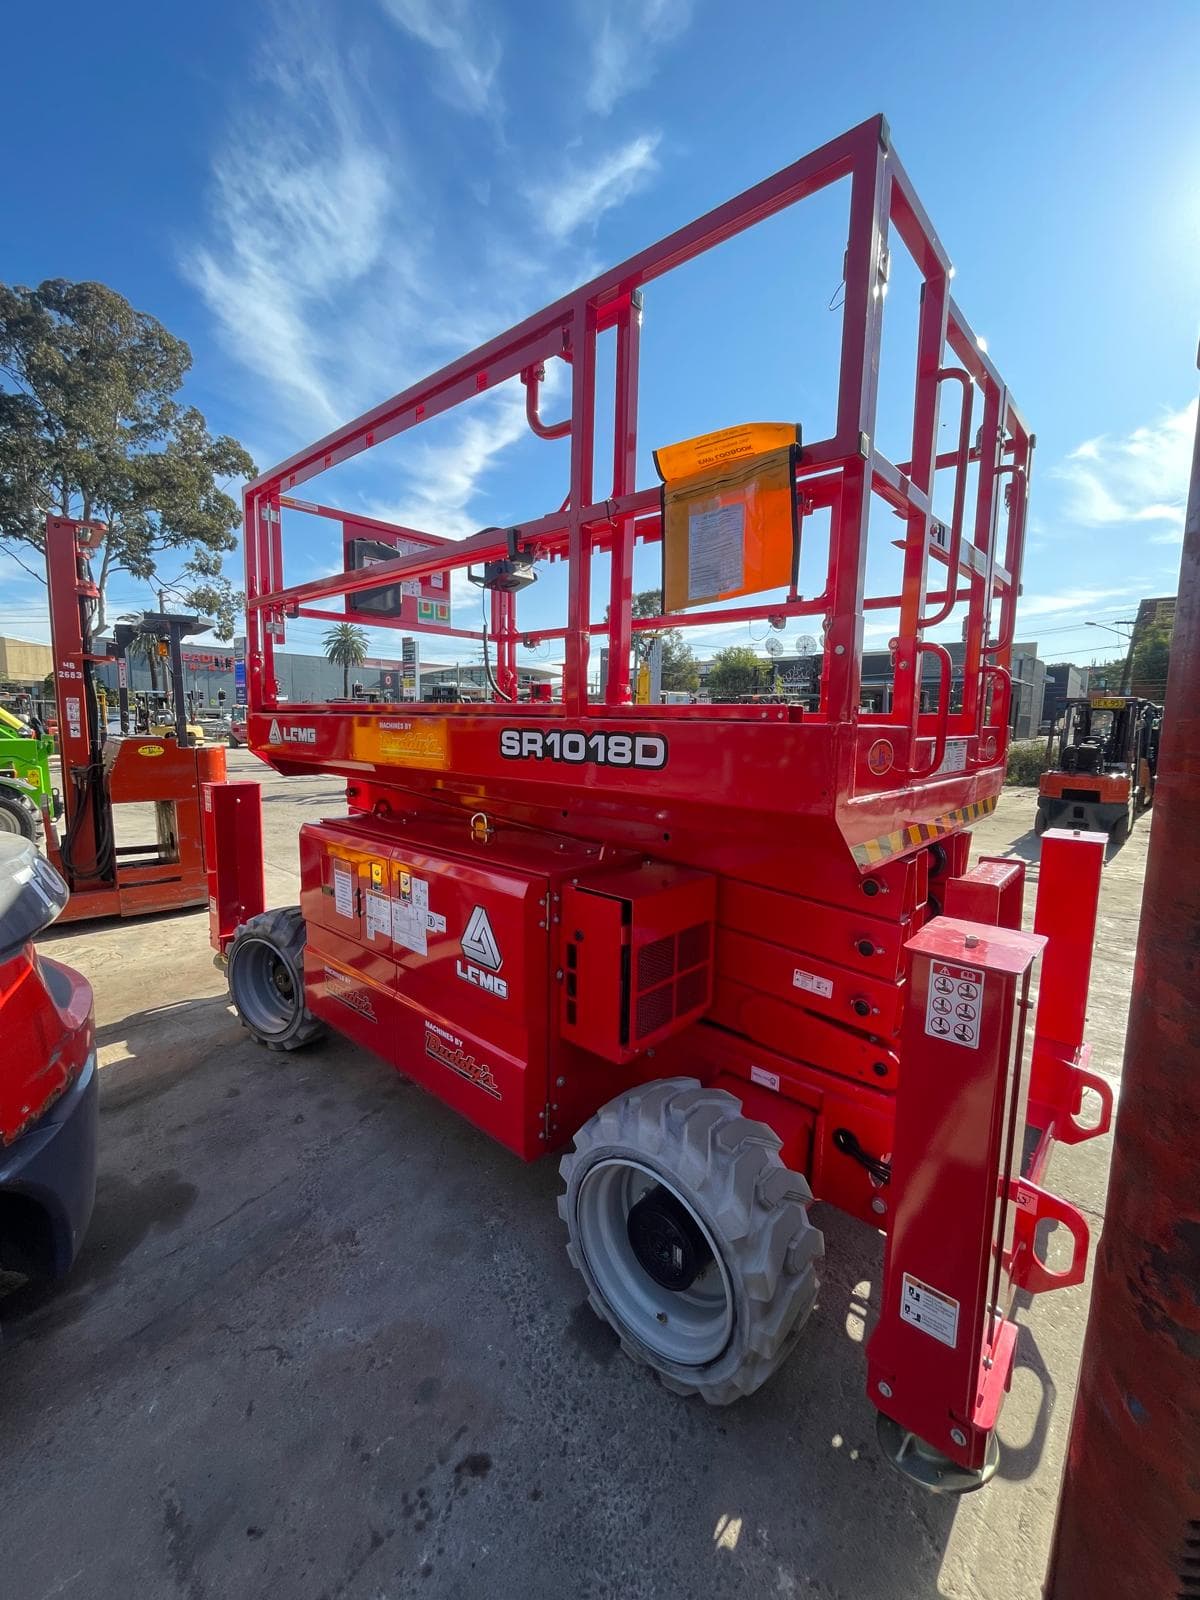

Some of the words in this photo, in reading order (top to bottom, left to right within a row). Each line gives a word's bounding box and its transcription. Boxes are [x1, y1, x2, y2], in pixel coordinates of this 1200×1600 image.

[501, 730, 666, 768] SR1018D
[424, 1020, 453, 1043] MACHINES
[454, 1036, 464, 1048] BY
